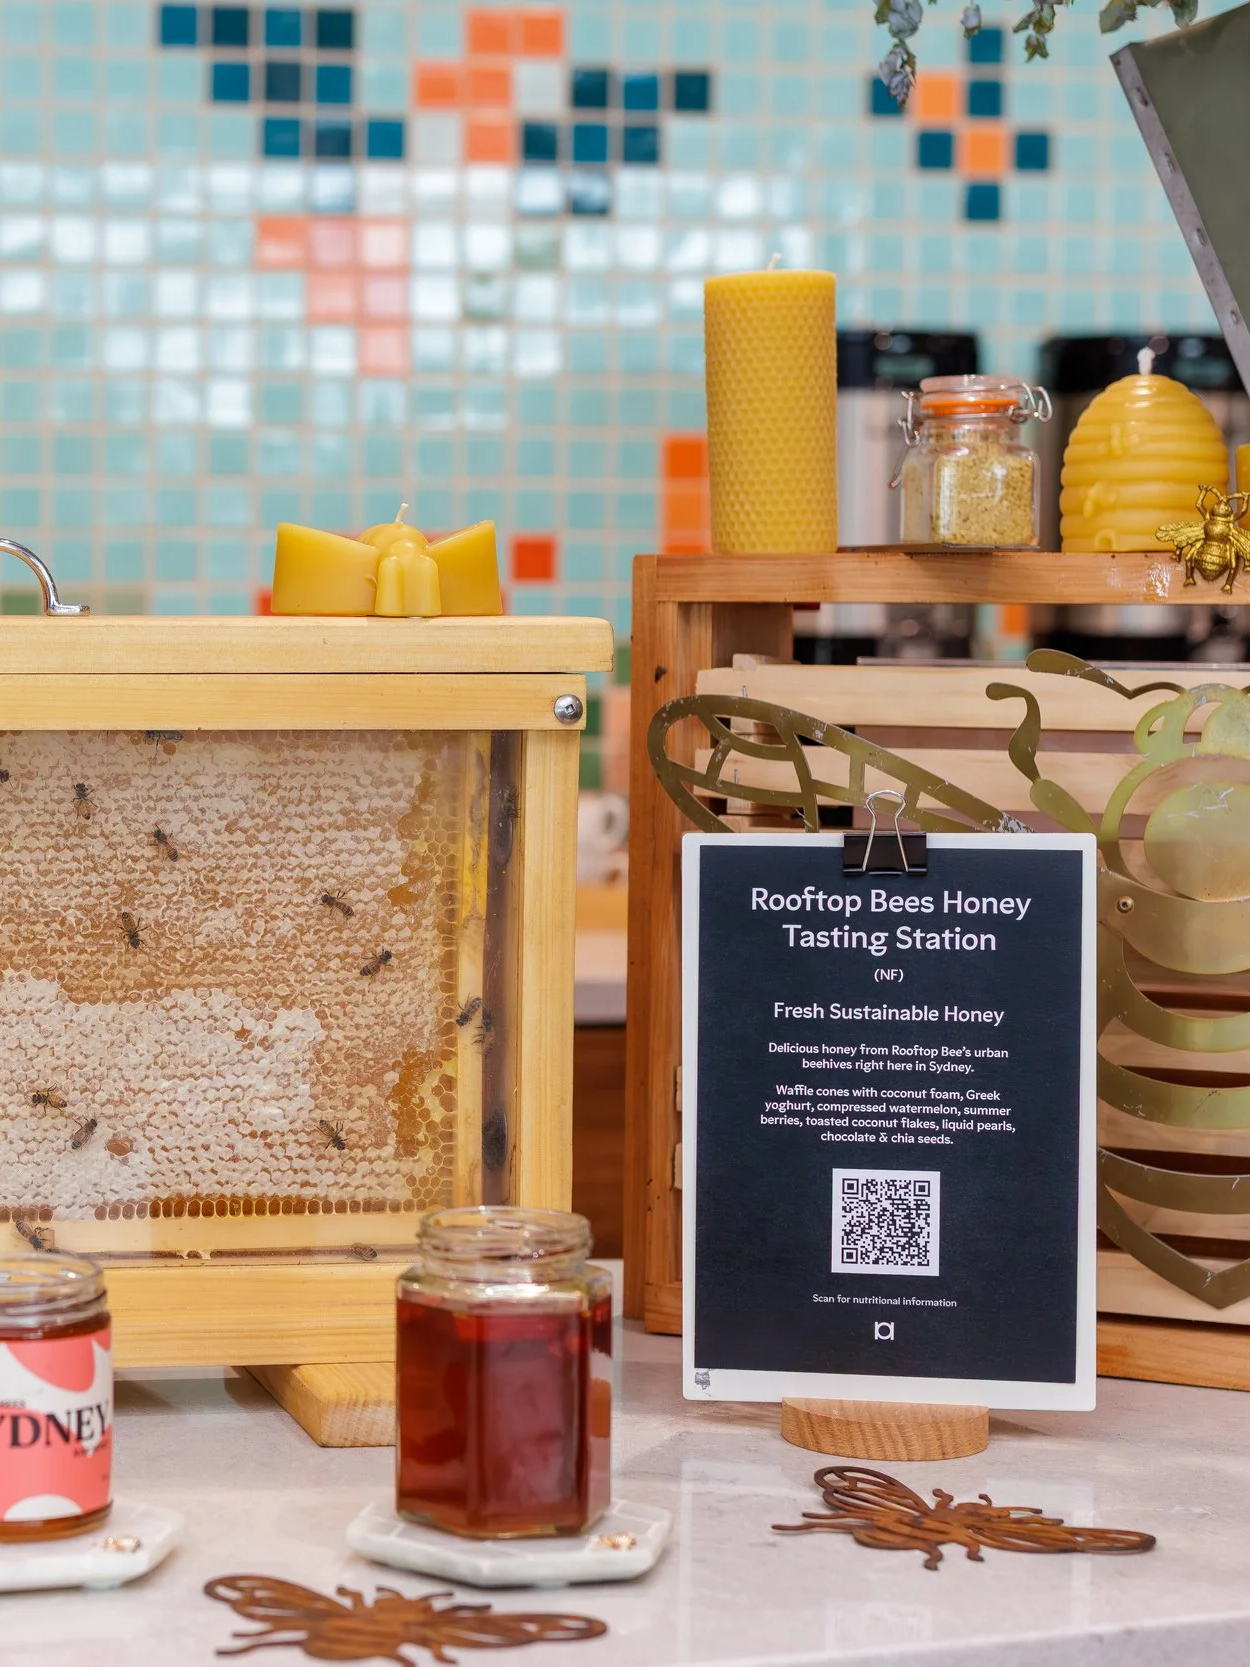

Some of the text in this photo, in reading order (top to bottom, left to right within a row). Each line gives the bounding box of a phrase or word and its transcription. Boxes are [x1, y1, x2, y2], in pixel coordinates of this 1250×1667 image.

[751, 885, 1032, 921] Rooftop Bees Honey
[781, 924, 997, 957] Tasting Station
[873, 968, 904, 983] (NF)
[774, 1001, 1005, 1027] Fresh Sustainable Honey
[768, 1042, 1009, 1059] Delicious honey from Rooftop Bee’s urban
[802, 1057, 975, 1075] beehives right here in Sydney.
[775, 1084, 1001, 1102] Waffle cones with coconut foam, Greek
[764, 1099, 1012, 1117] yoghurt, compressed watermelon, summer
[760, 1114, 1016, 1134] berries, toasted coconut flakes, liquid pearls,
[820, 1130, 954, 1145] chocolate & chia seeds.
[812, 1293, 958, 1308] Scan for nutritional information
